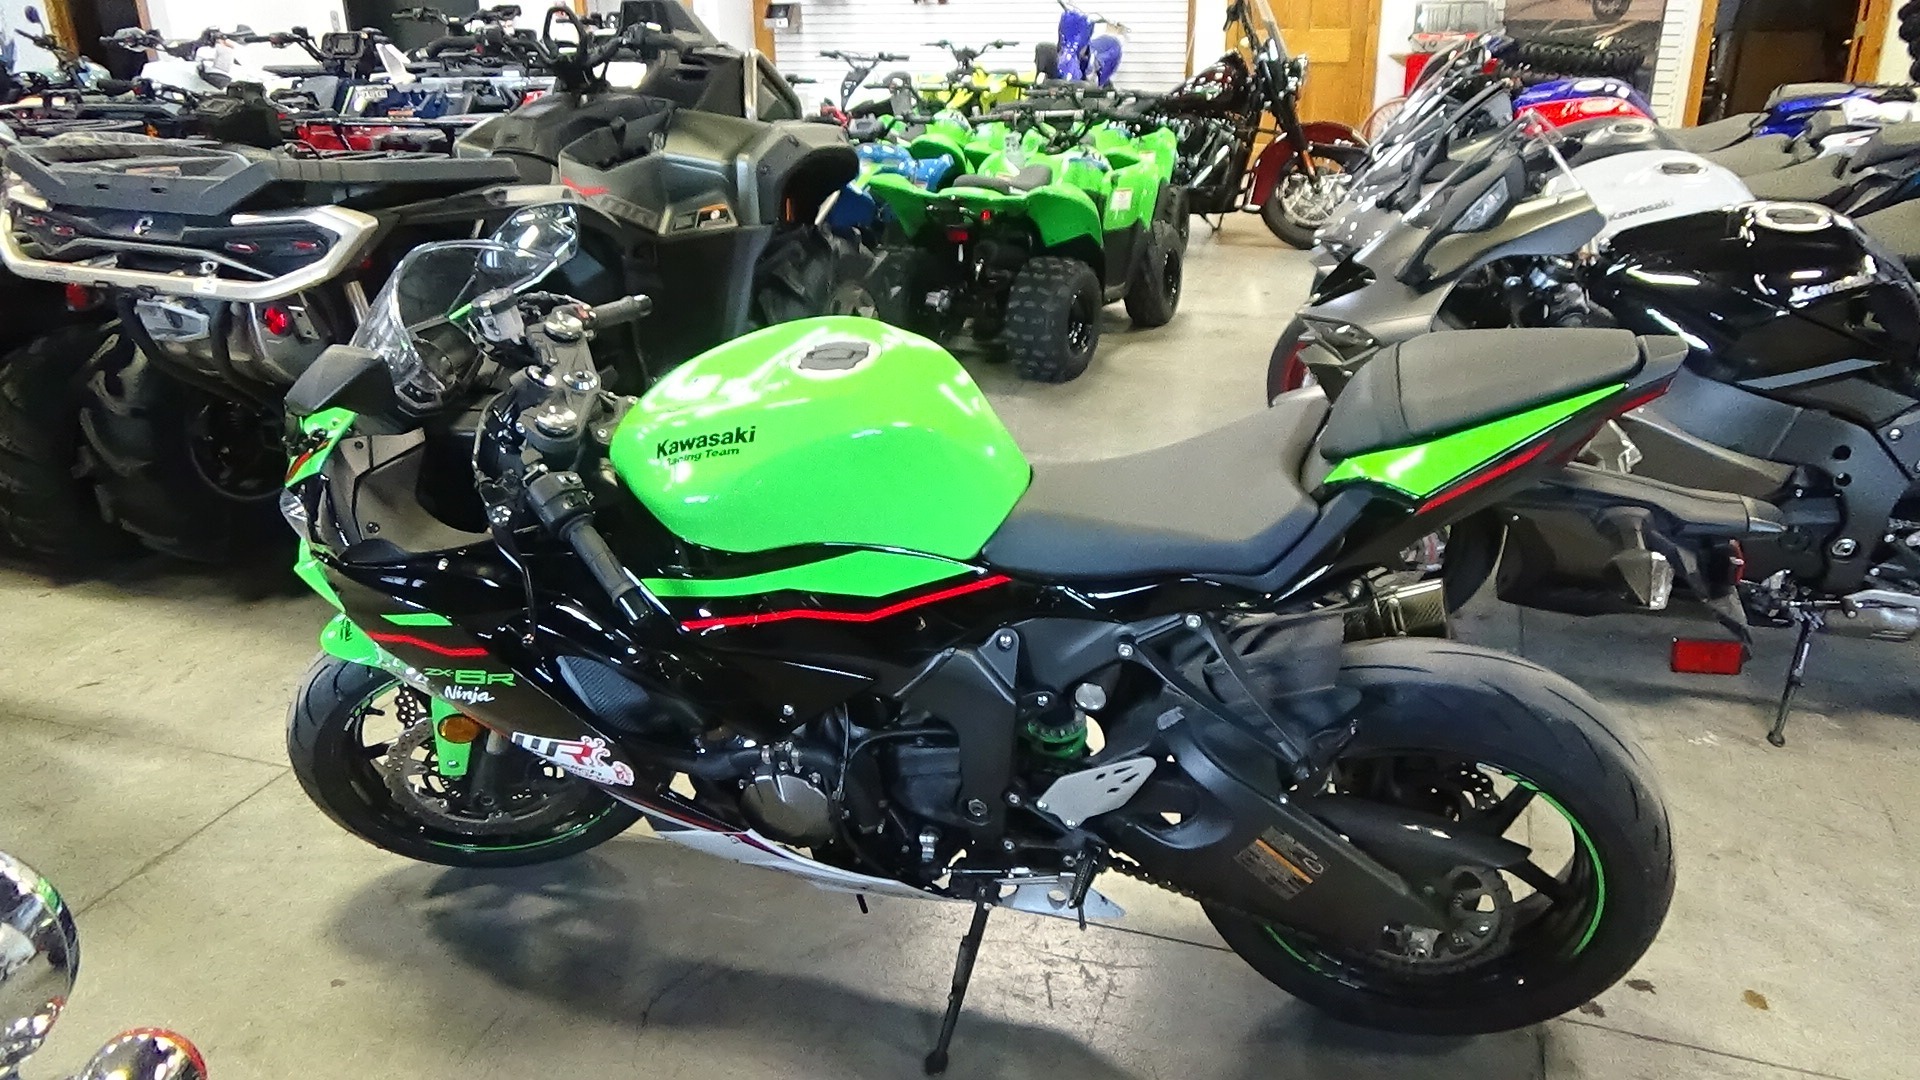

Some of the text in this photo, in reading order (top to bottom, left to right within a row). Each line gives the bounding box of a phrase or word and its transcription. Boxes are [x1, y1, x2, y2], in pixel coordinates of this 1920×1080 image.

[657, 426, 756, 459] Kawasaki
[705, 447, 740, 459] Team
[444, 685, 496, 705] Ninja
